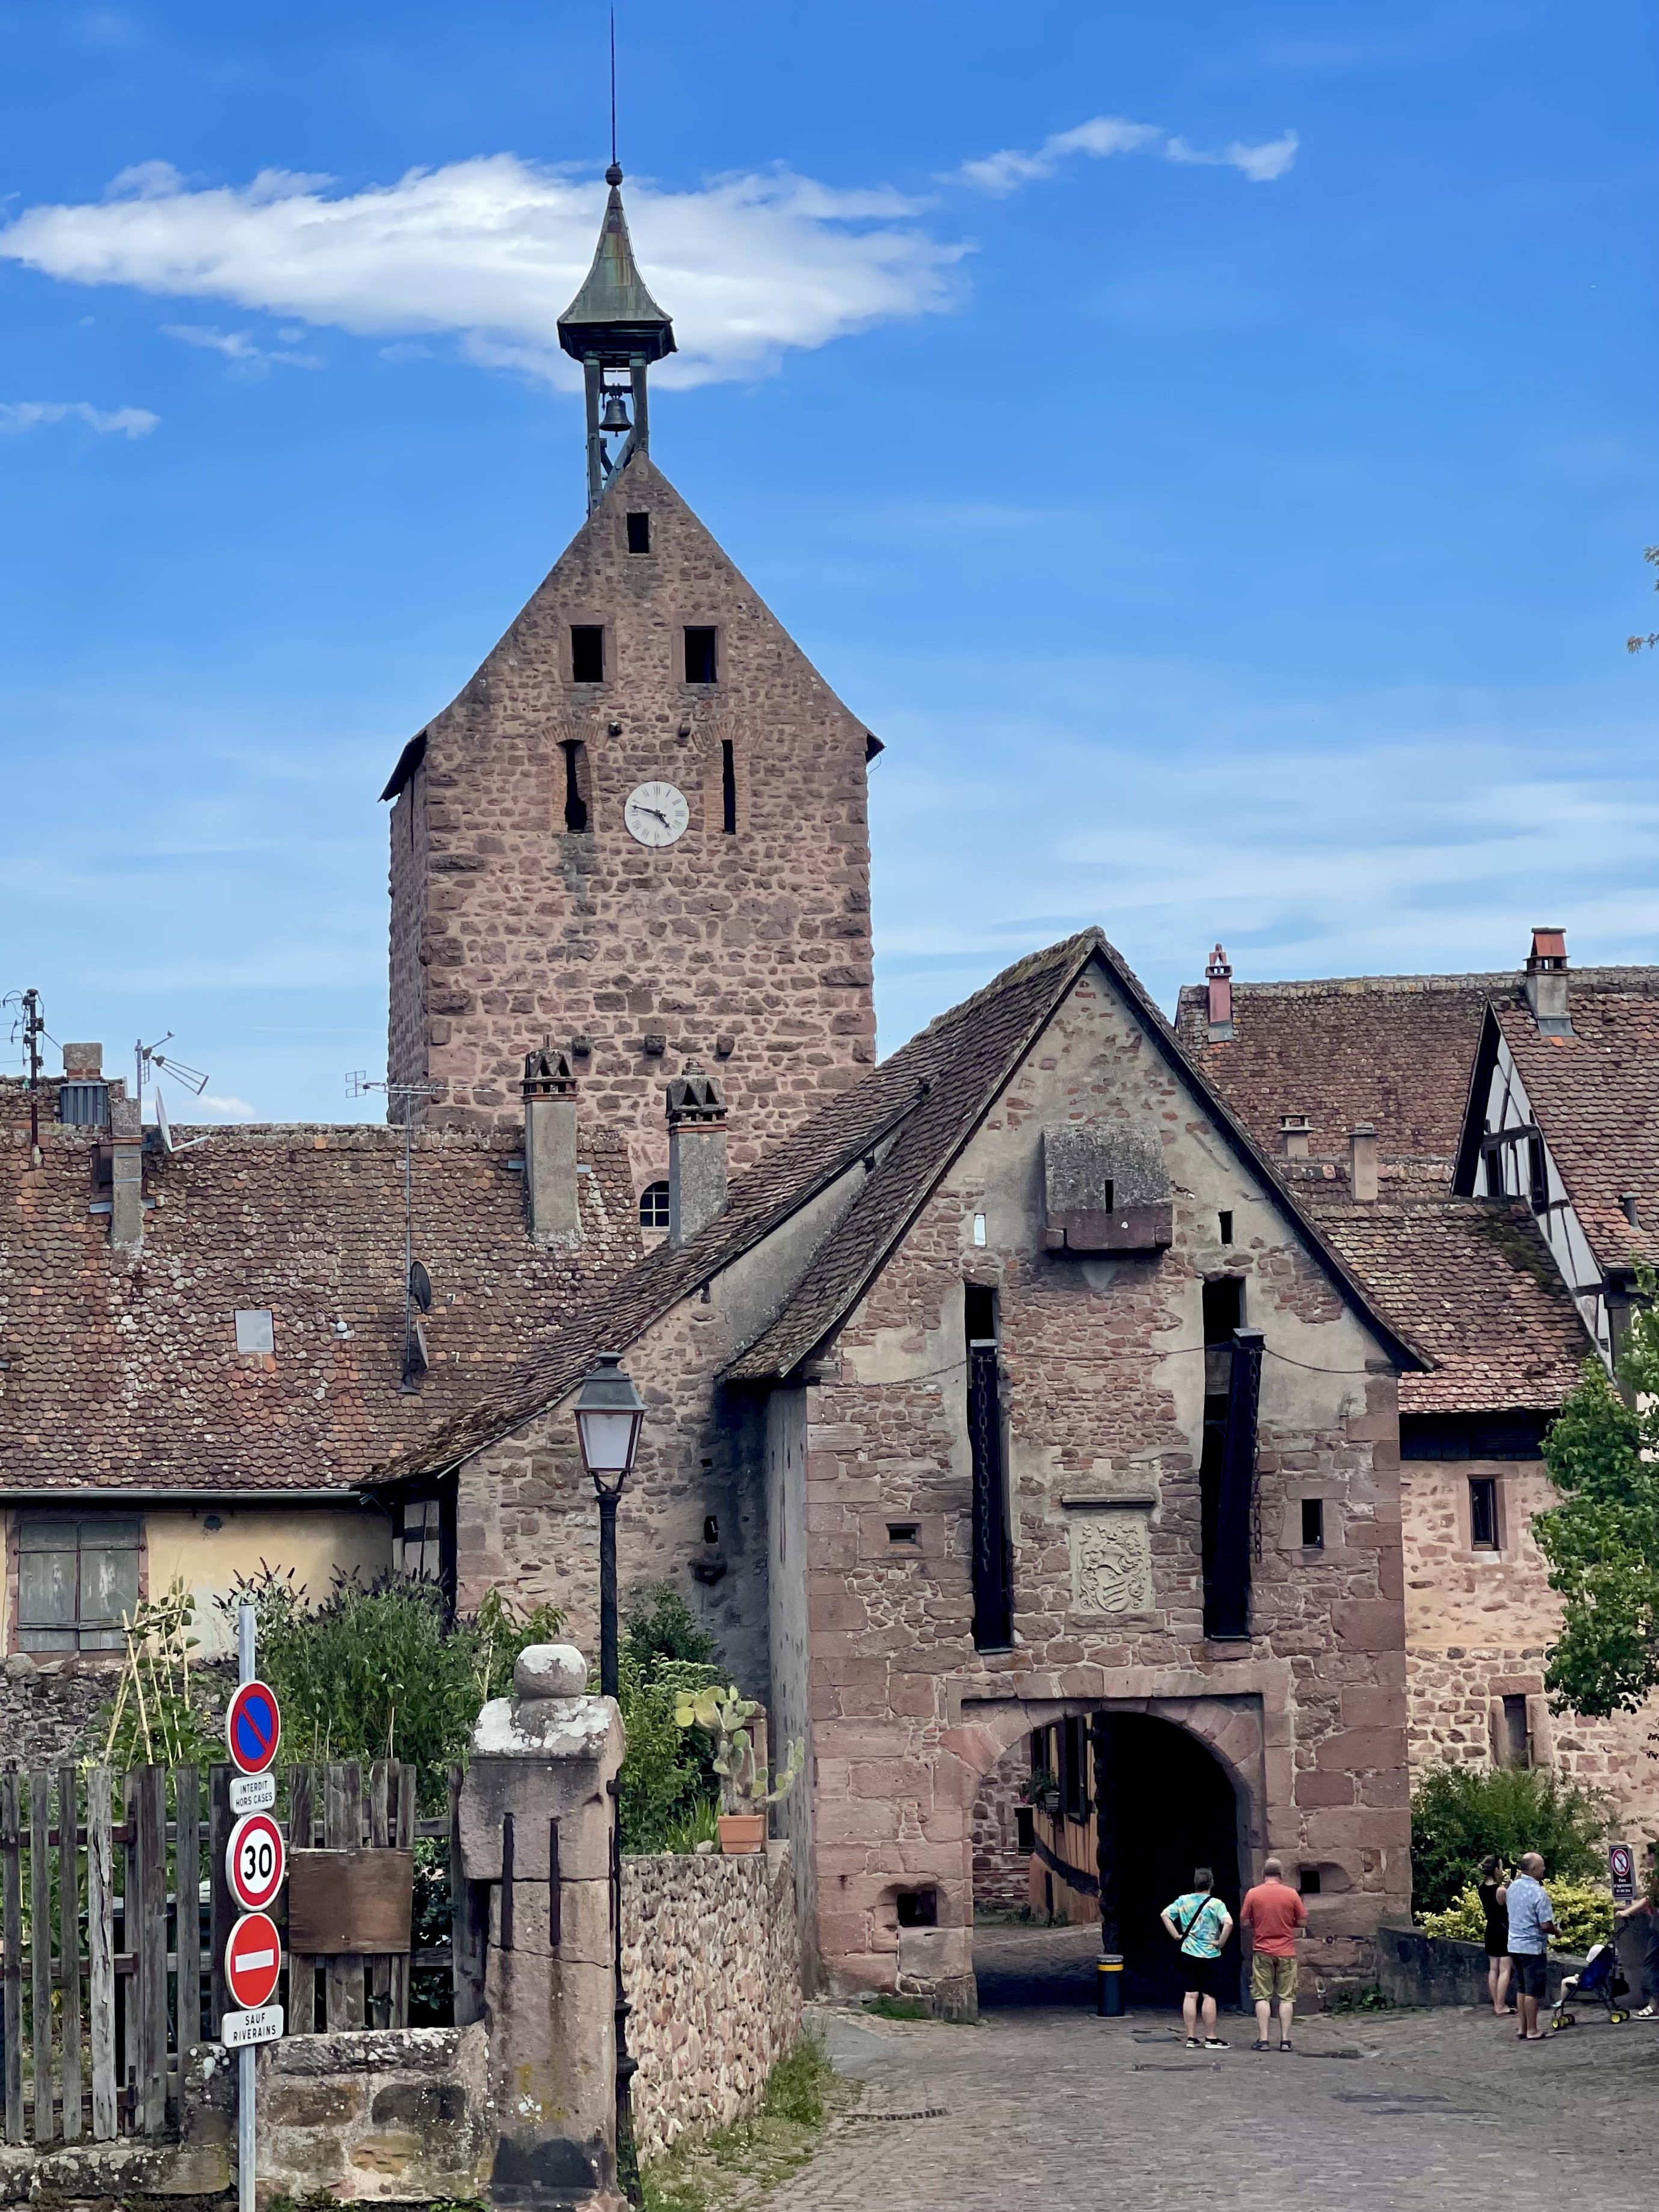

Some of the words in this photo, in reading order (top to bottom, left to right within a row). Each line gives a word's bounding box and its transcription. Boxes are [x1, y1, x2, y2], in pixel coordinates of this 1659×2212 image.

[240, 1780, 268, 1795] INTERDIT
[236, 1796, 251, 1807] HORS
[253, 1792, 272, 1804] CASES
[244, 1843, 272, 1880] 30
[245, 2012, 265, 2026] SAUF
[233, 2025, 276, 2042] RIVERAINS
